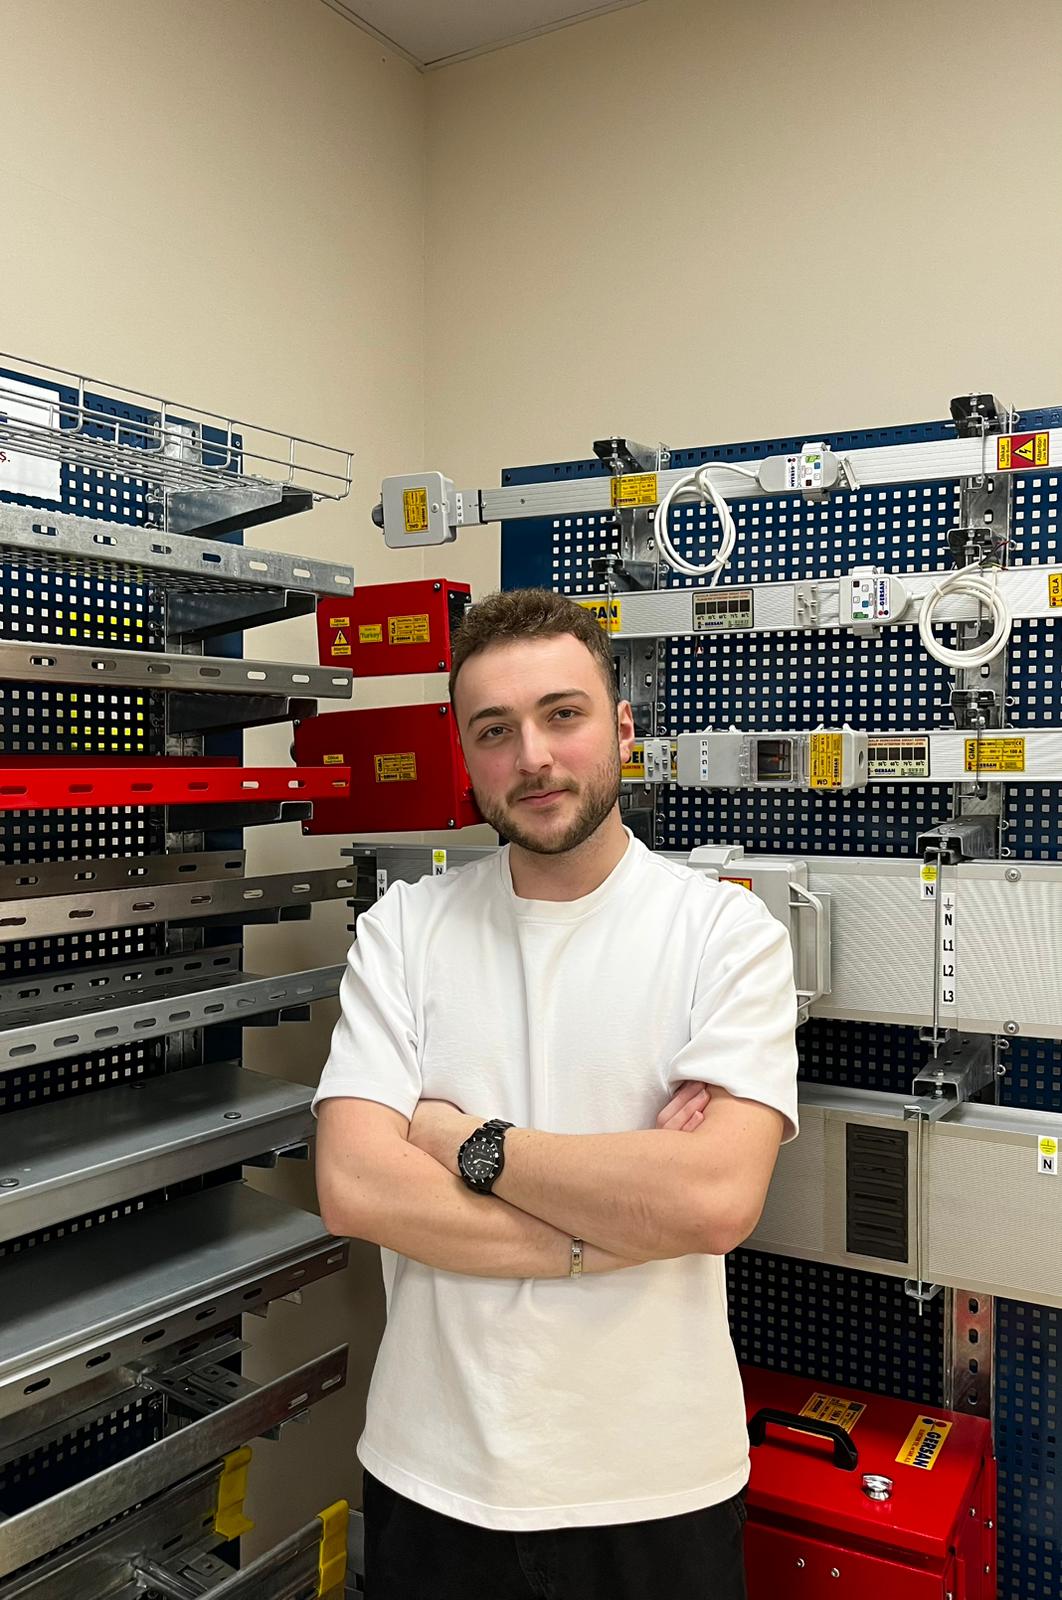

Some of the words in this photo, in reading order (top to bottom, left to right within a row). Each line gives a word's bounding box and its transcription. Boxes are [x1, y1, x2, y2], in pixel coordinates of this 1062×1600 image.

[590, 605, 618, 619] SAN
[436, 867, 443, 875] N
[379, 887, 385, 896] N
[925, 886, 934, 895] N
[944, 914, 952, 925] N
[943, 940, 954, 951] L1
[943, 965, 954, 976] L2
[943, 991, 954, 1002] L3
[1043, 1159, 1052, 1169] N
[912, 1431, 941, 1468] GERSAN
